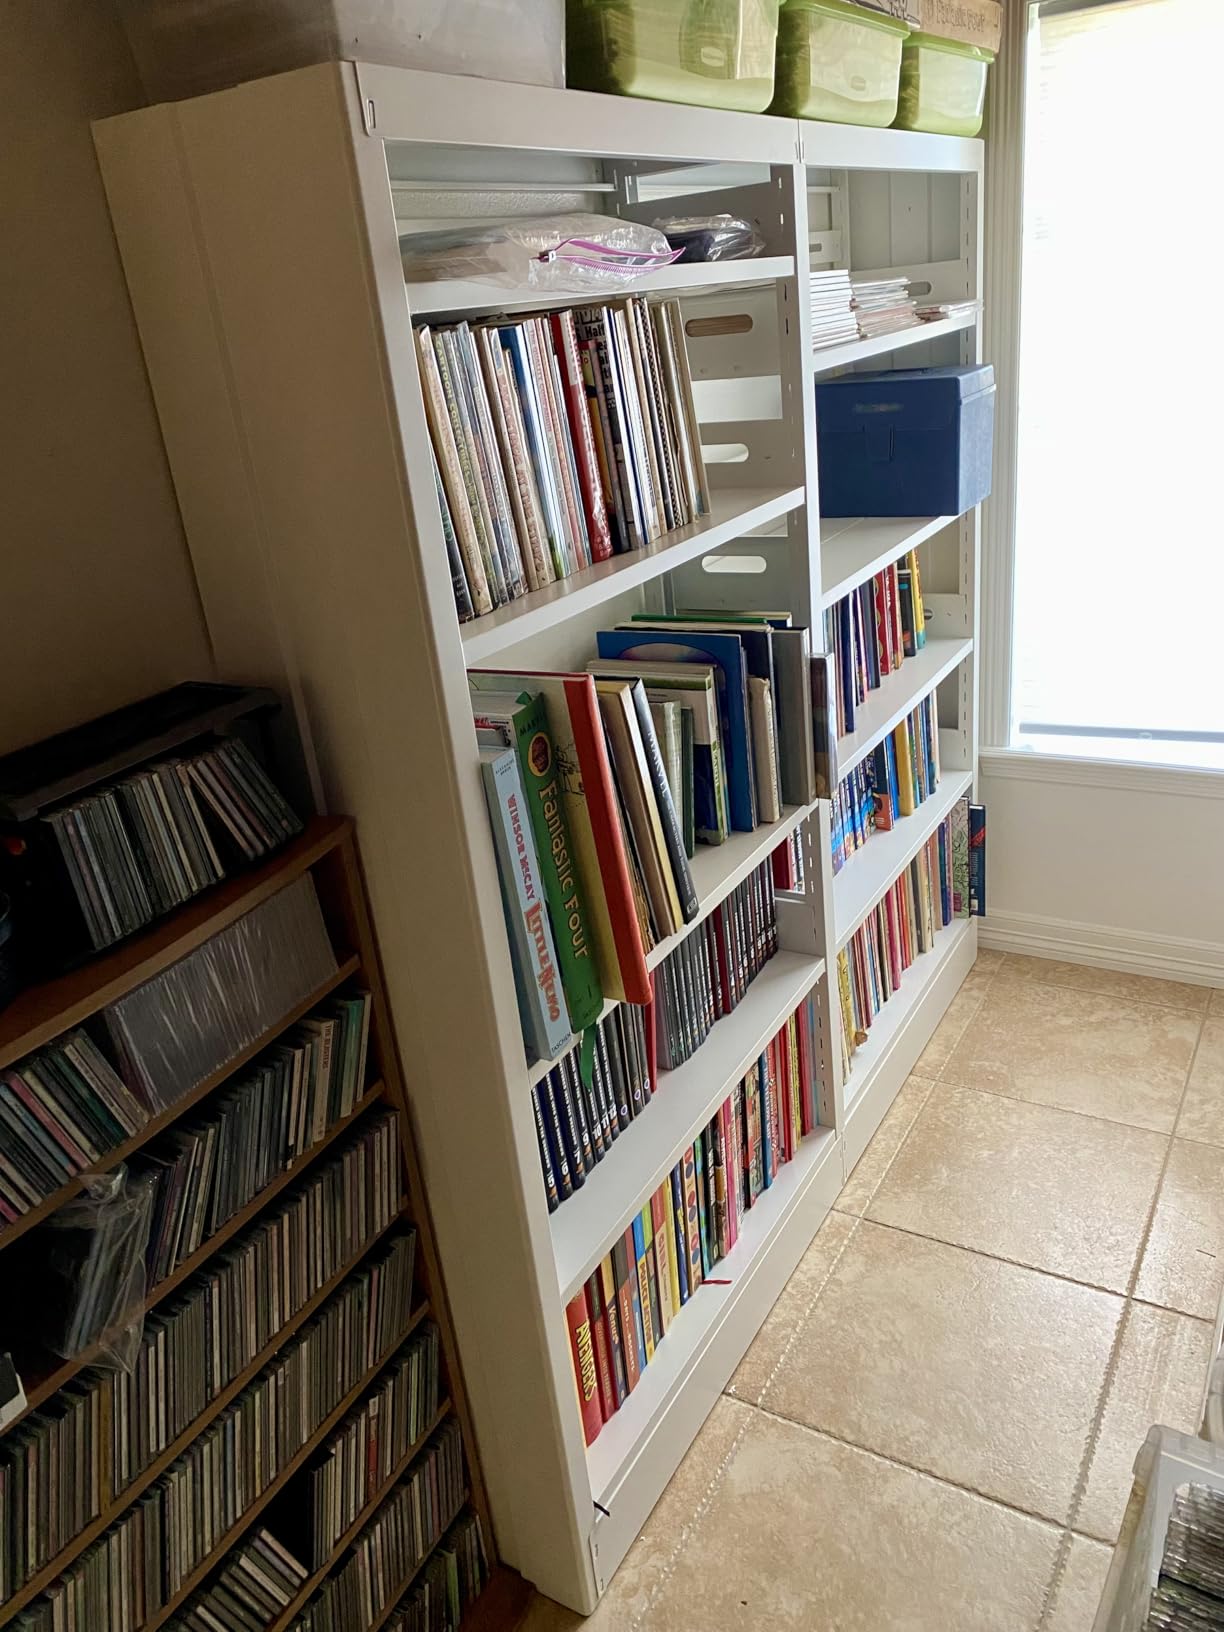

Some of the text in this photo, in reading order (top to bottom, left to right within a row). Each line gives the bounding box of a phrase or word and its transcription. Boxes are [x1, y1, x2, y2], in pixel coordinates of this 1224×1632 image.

[648, 731, 668, 797] MARVEL
[507, 792, 525, 853] WINSOR
[539, 780, 589, 959] Fantastic Four
[552, 1032, 572, 1052] TASCHEN
[582, 1134, 590, 1145] 9
[592, 1126, 602, 1140] 10
[602, 1115, 610, 1128] 11
[638, 1262, 649, 1302] POLICE
[608, 1304, 619, 1342] Venus
[576, 1321, 597, 1402] AVENGERS
